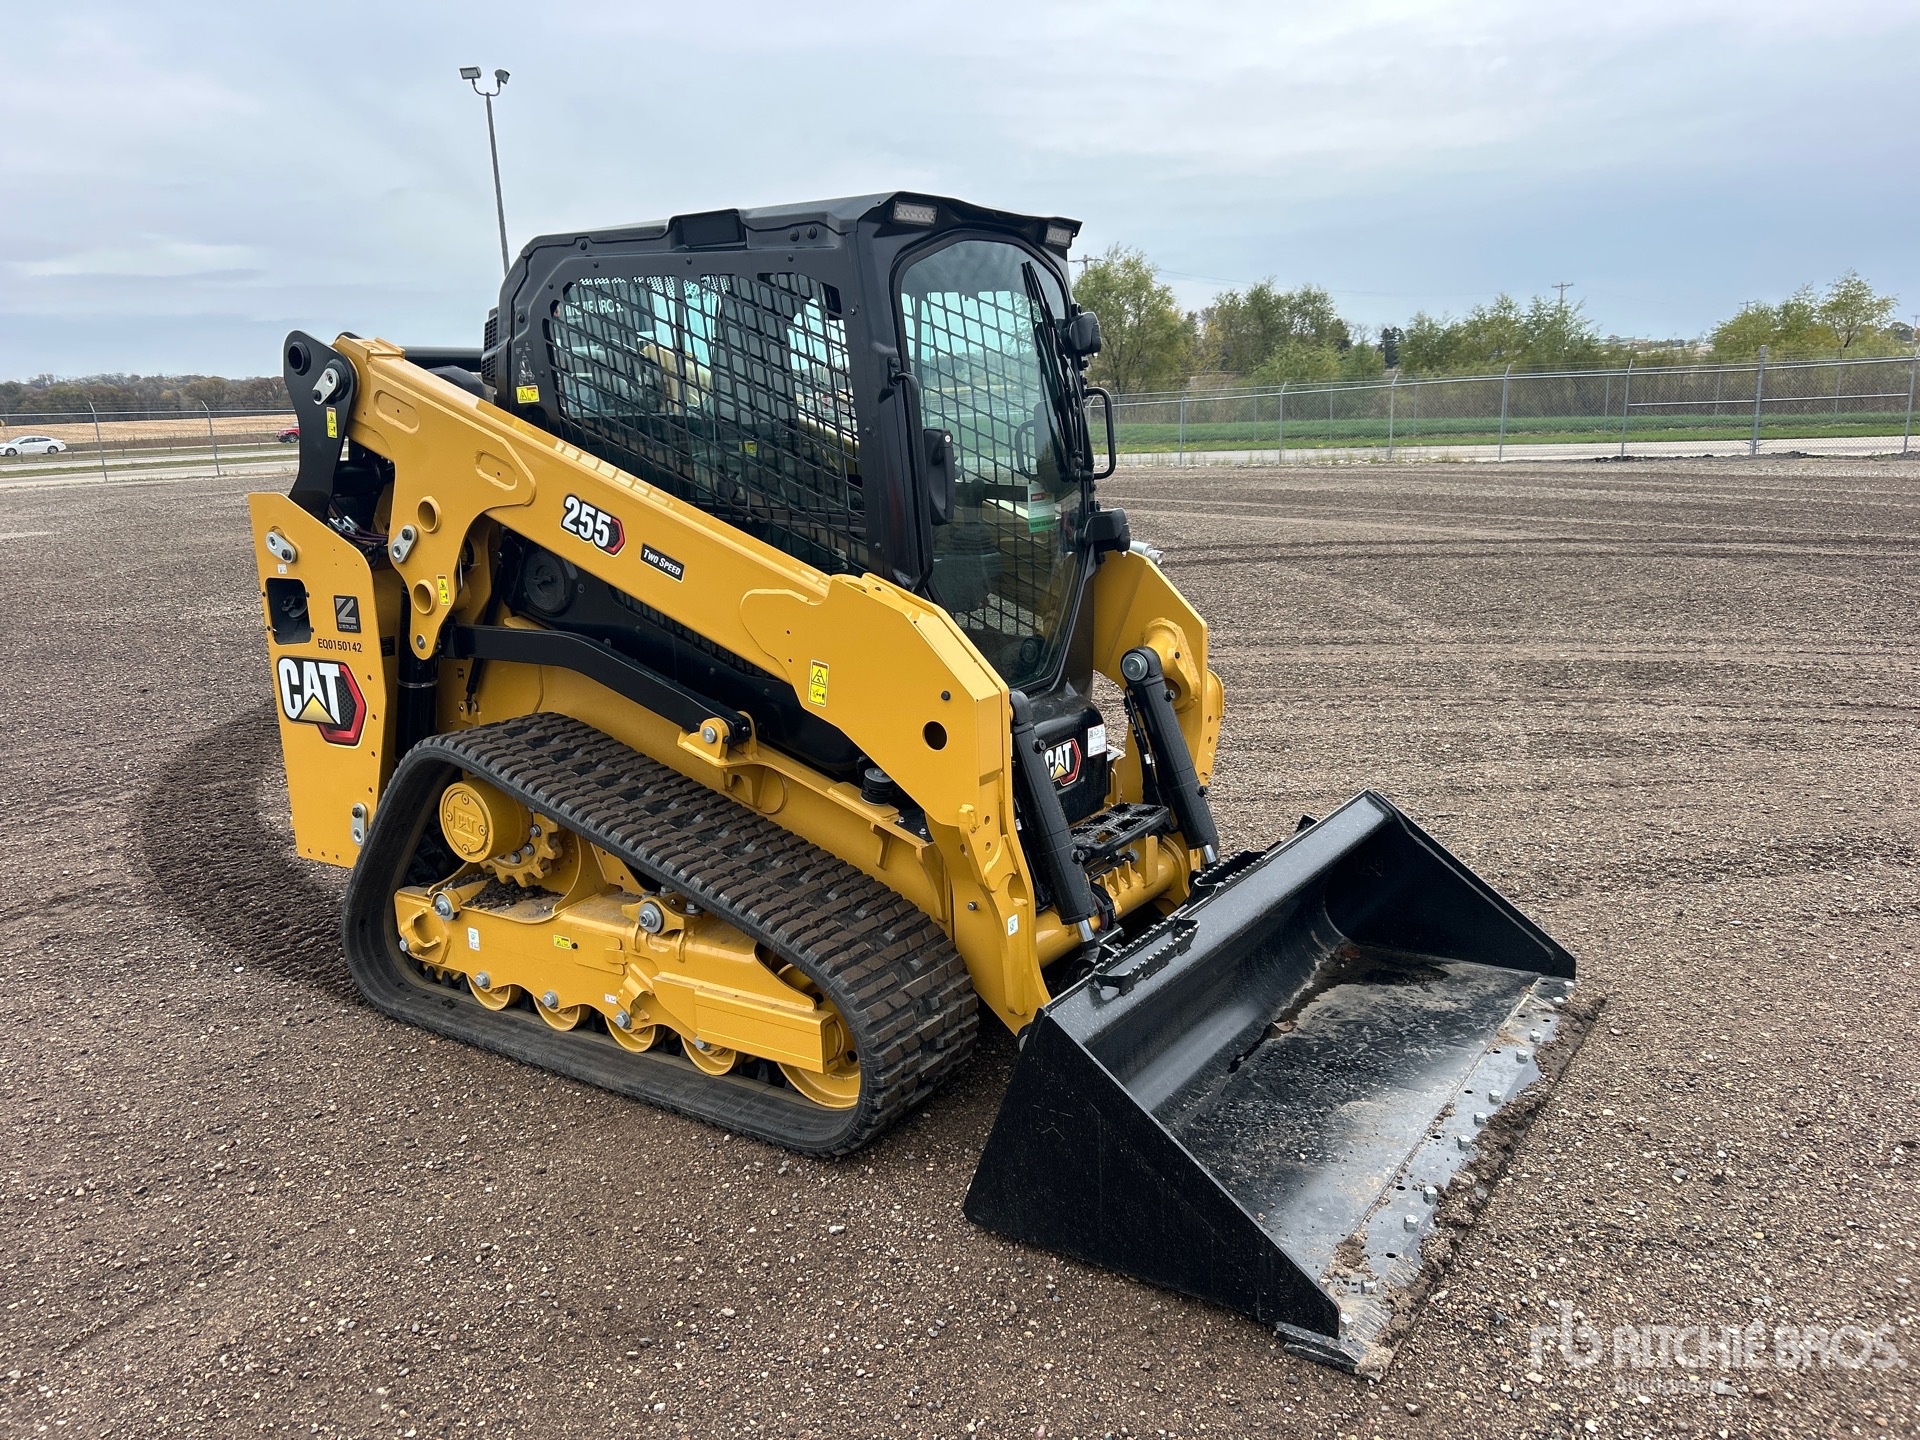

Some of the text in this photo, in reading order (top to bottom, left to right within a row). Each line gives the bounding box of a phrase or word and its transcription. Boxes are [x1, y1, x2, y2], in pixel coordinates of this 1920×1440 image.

[562, 496, 612, 548] 255
[317, 638, 363, 653] EQ0150142
[278, 658, 341, 724] CAT
[1044, 742, 1072, 778] CAT
